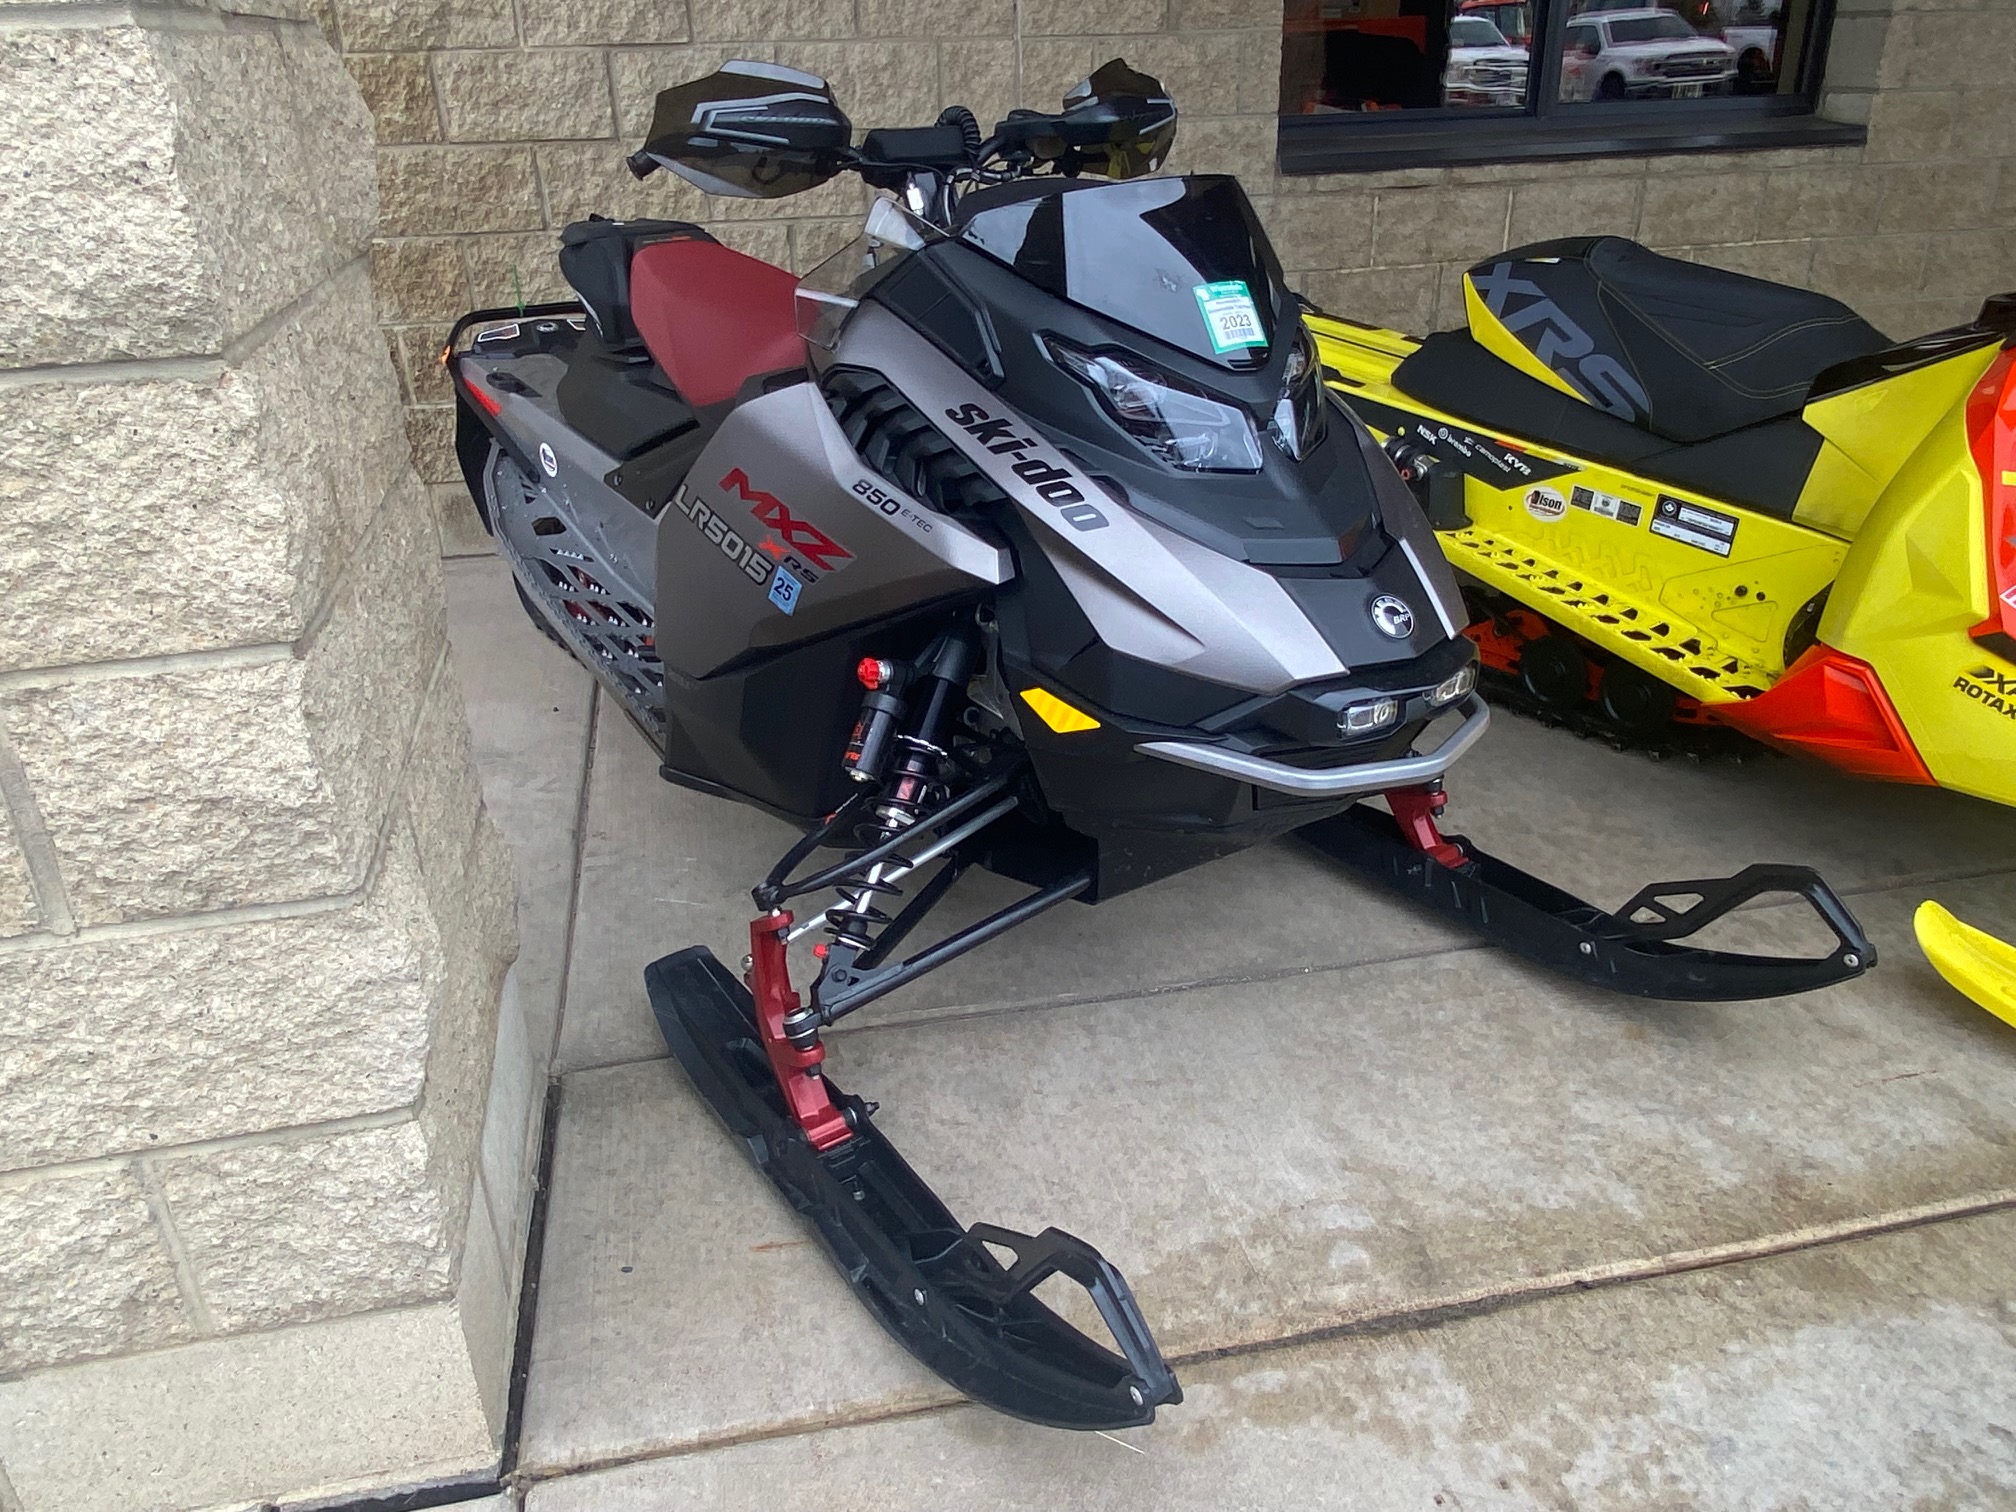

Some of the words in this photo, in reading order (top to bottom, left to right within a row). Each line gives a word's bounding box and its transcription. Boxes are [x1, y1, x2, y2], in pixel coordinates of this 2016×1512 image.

[1220, 314, 1252, 331] 2023
[1471, 262, 1650, 423] XRS
[1416, 424, 1438, 446] NSK
[1447, 433, 1472, 458] brembo
[945, 403, 1110, 532] ski-doo
[852, 479, 901, 516] 850
[718, 467, 856, 571] MXZ
[773, 576, 794, 601] 25
[1393, 613, 1410, 625] BRP
